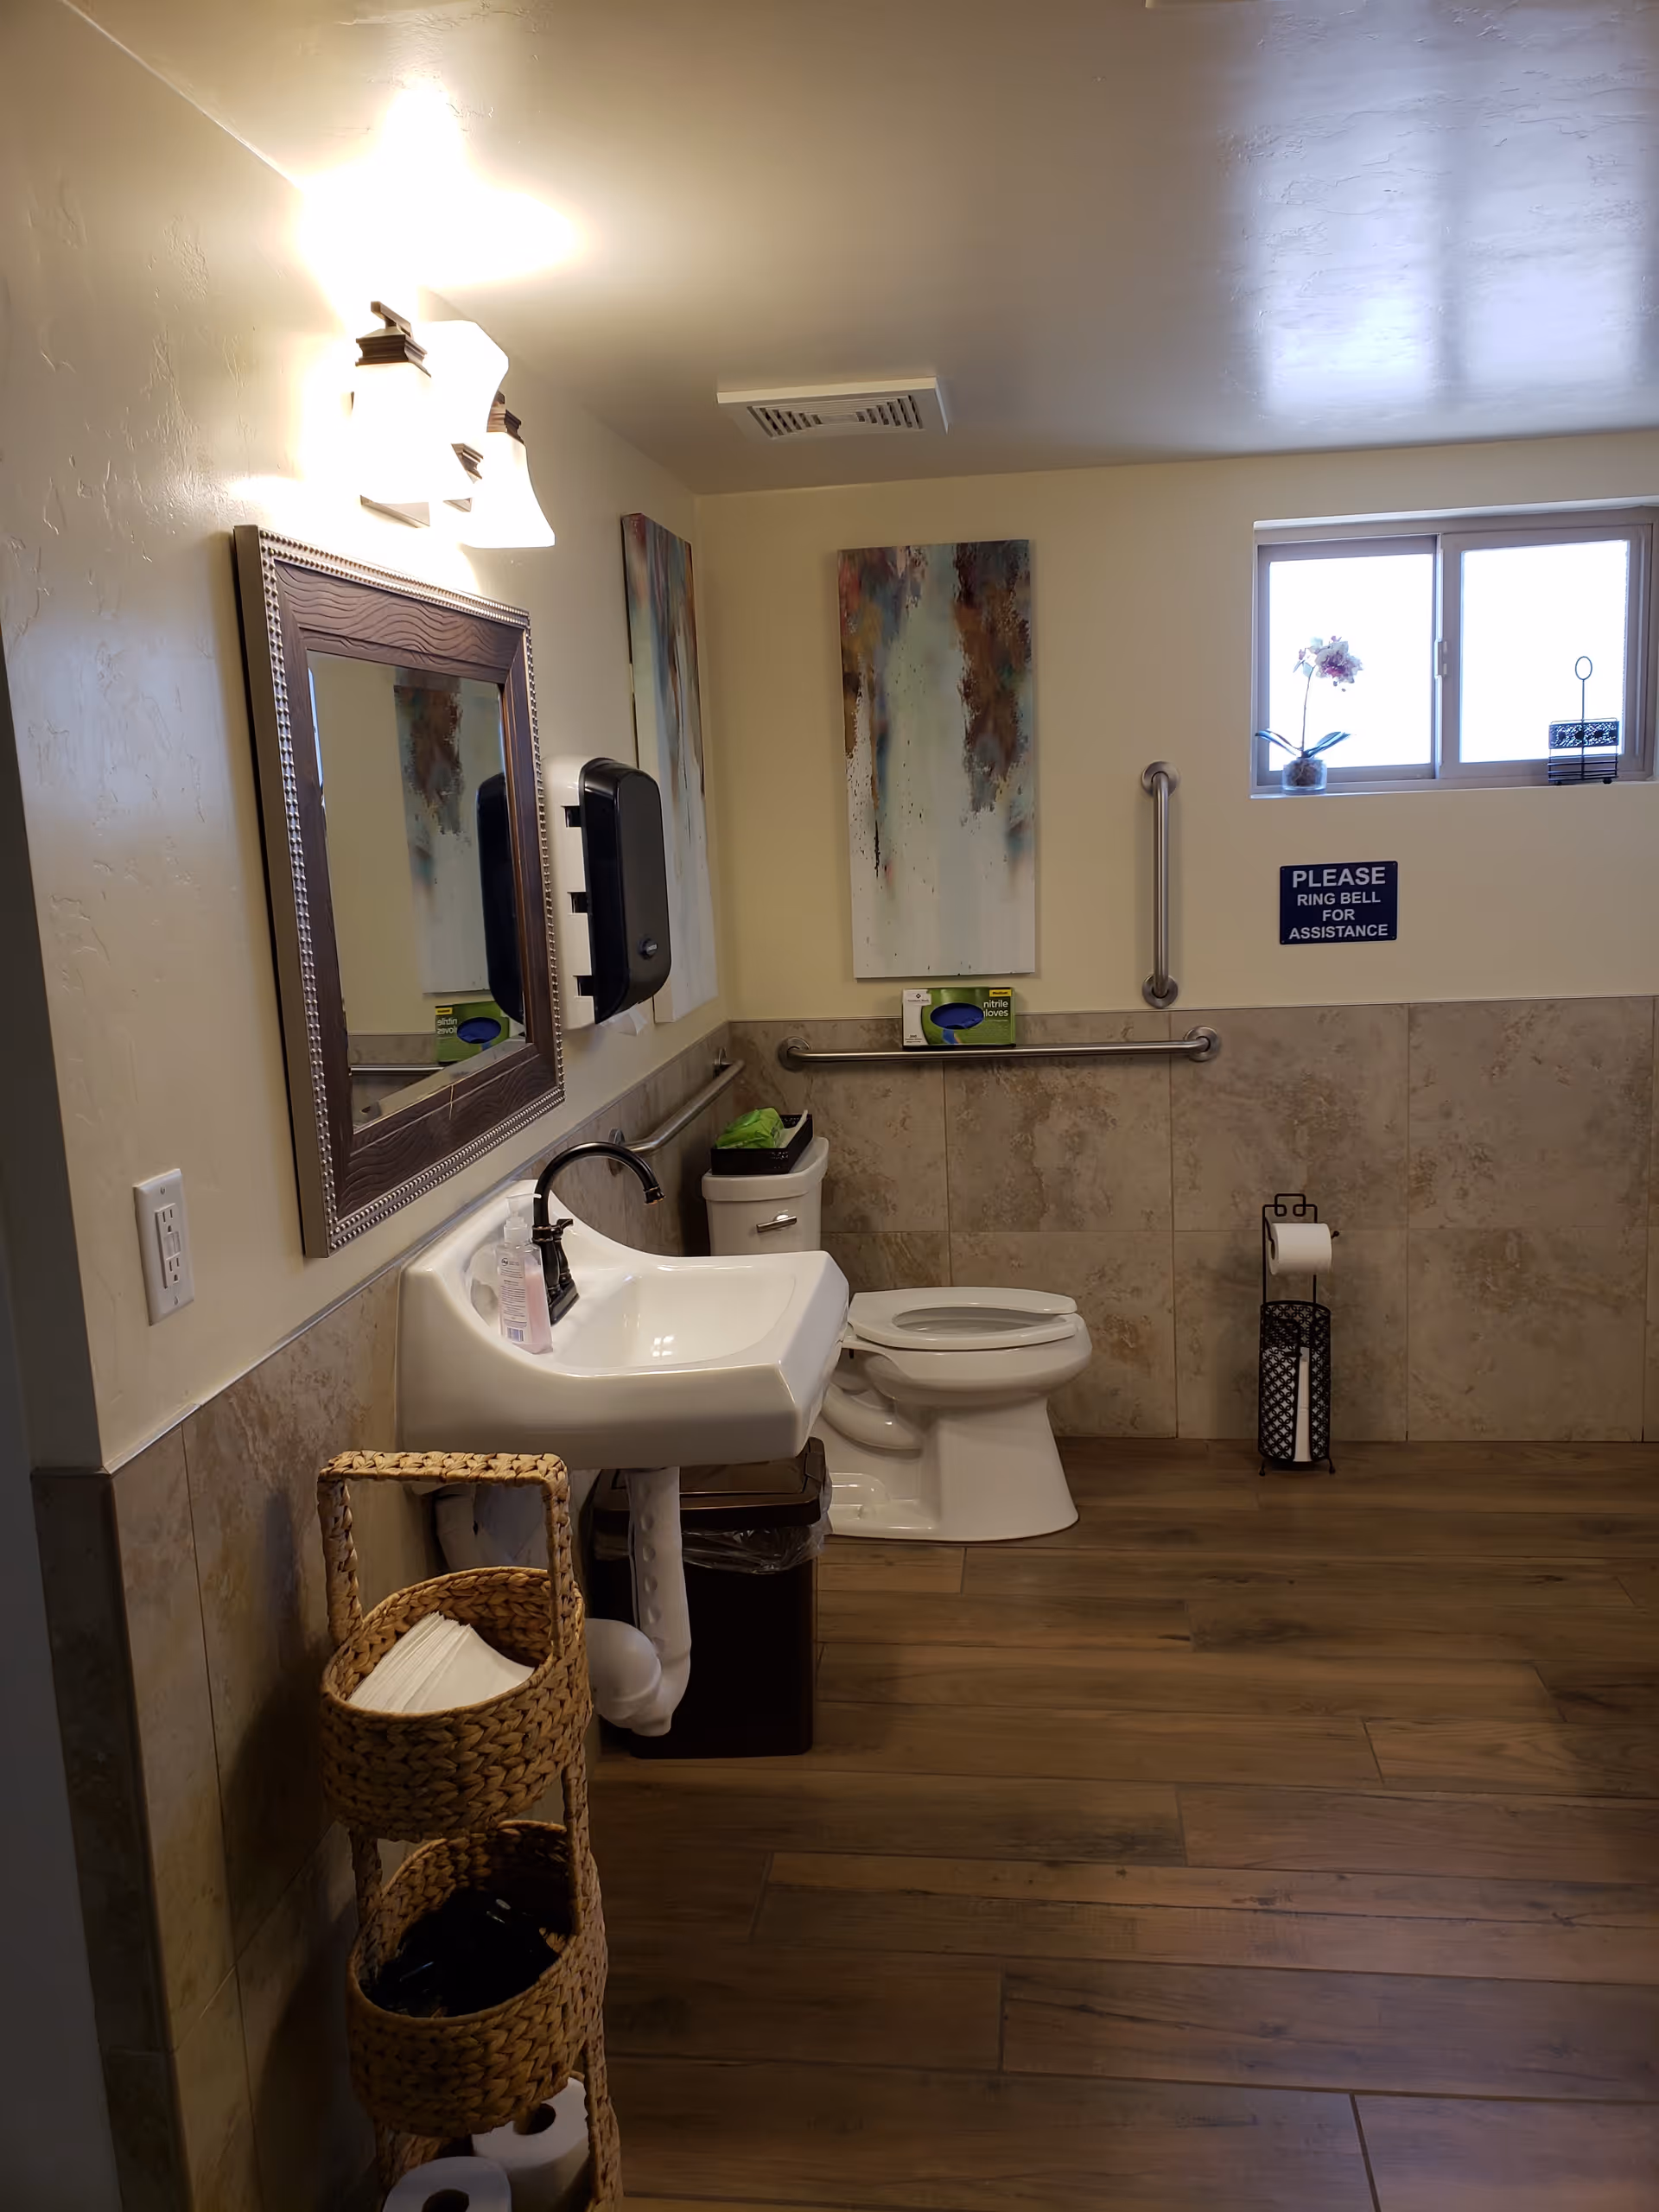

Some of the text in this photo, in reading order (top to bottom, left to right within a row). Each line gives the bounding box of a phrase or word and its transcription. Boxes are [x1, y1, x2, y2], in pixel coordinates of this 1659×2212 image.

[1293, 867, 1386, 888] PLEASE
[1297, 892, 1381, 906] RING BELL
[1322, 909, 1356, 921] FOR
[1288, 924, 1389, 940] ASSISTANCE
[983, 1000, 1008, 1008] nitrile
